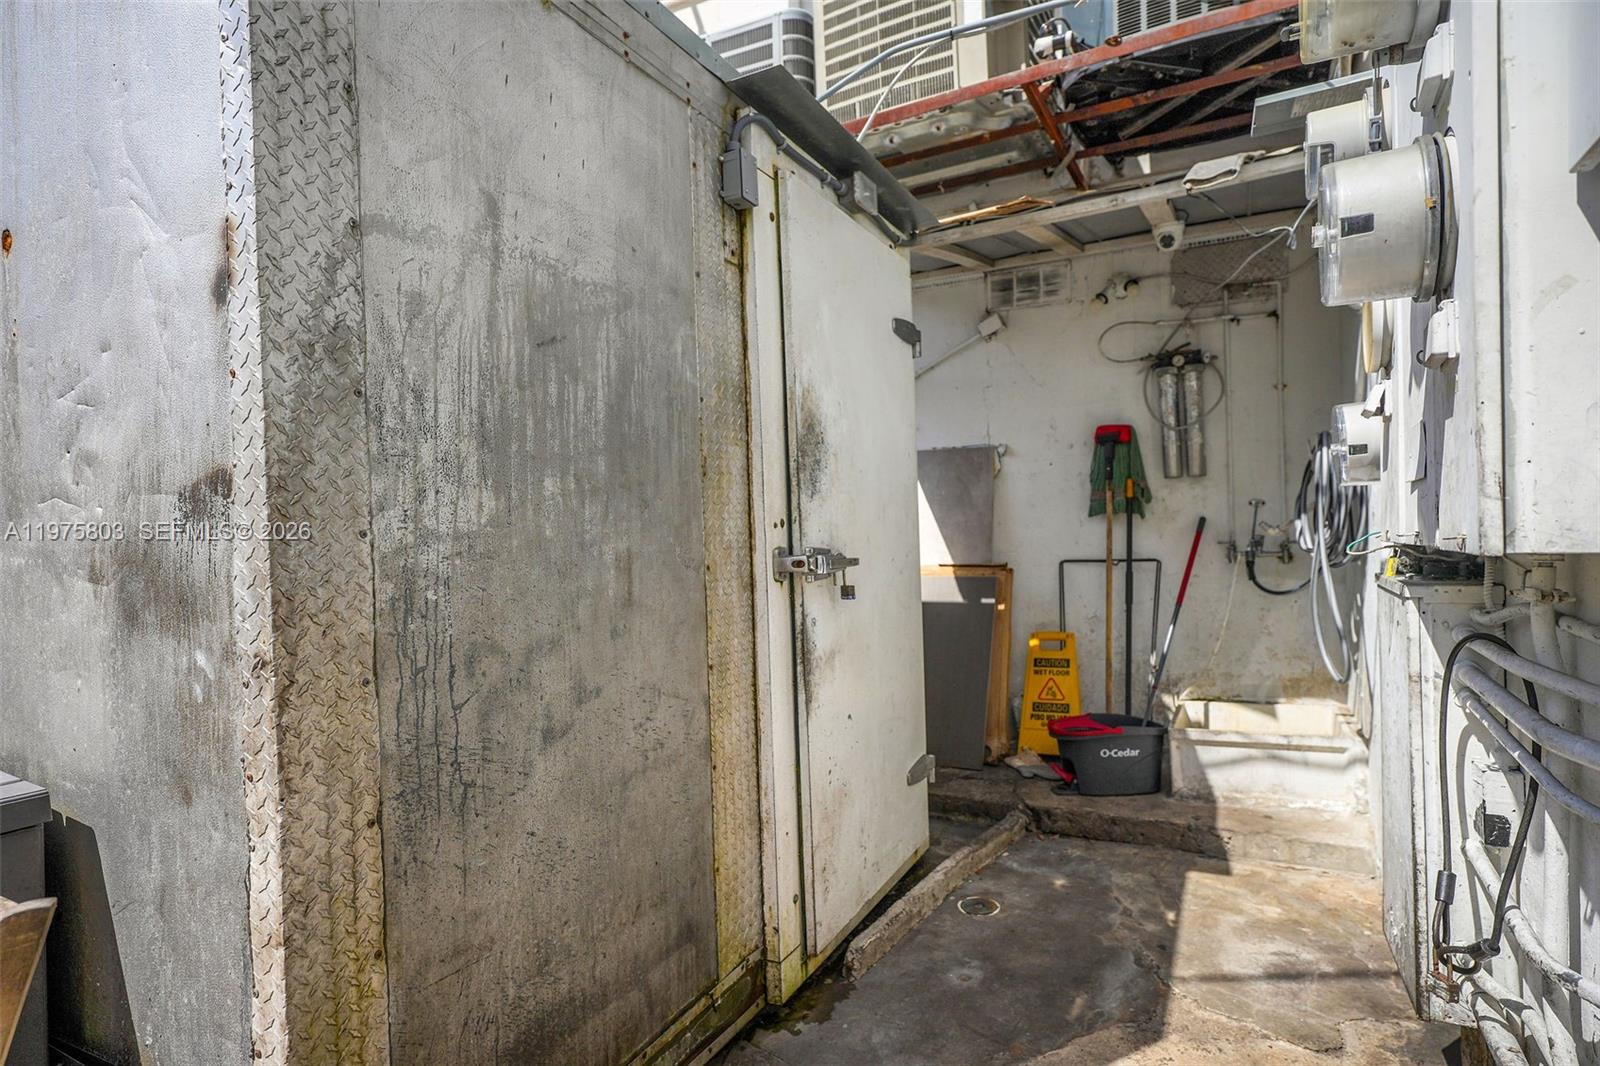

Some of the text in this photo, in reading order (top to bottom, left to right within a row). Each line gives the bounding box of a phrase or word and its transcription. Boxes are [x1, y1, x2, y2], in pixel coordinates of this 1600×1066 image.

[1036, 658, 1068, 667] CAUTION
[1034, 703, 1068, 712] CUIDADO
[1100, 748, 1140, 758] O-Cedar
